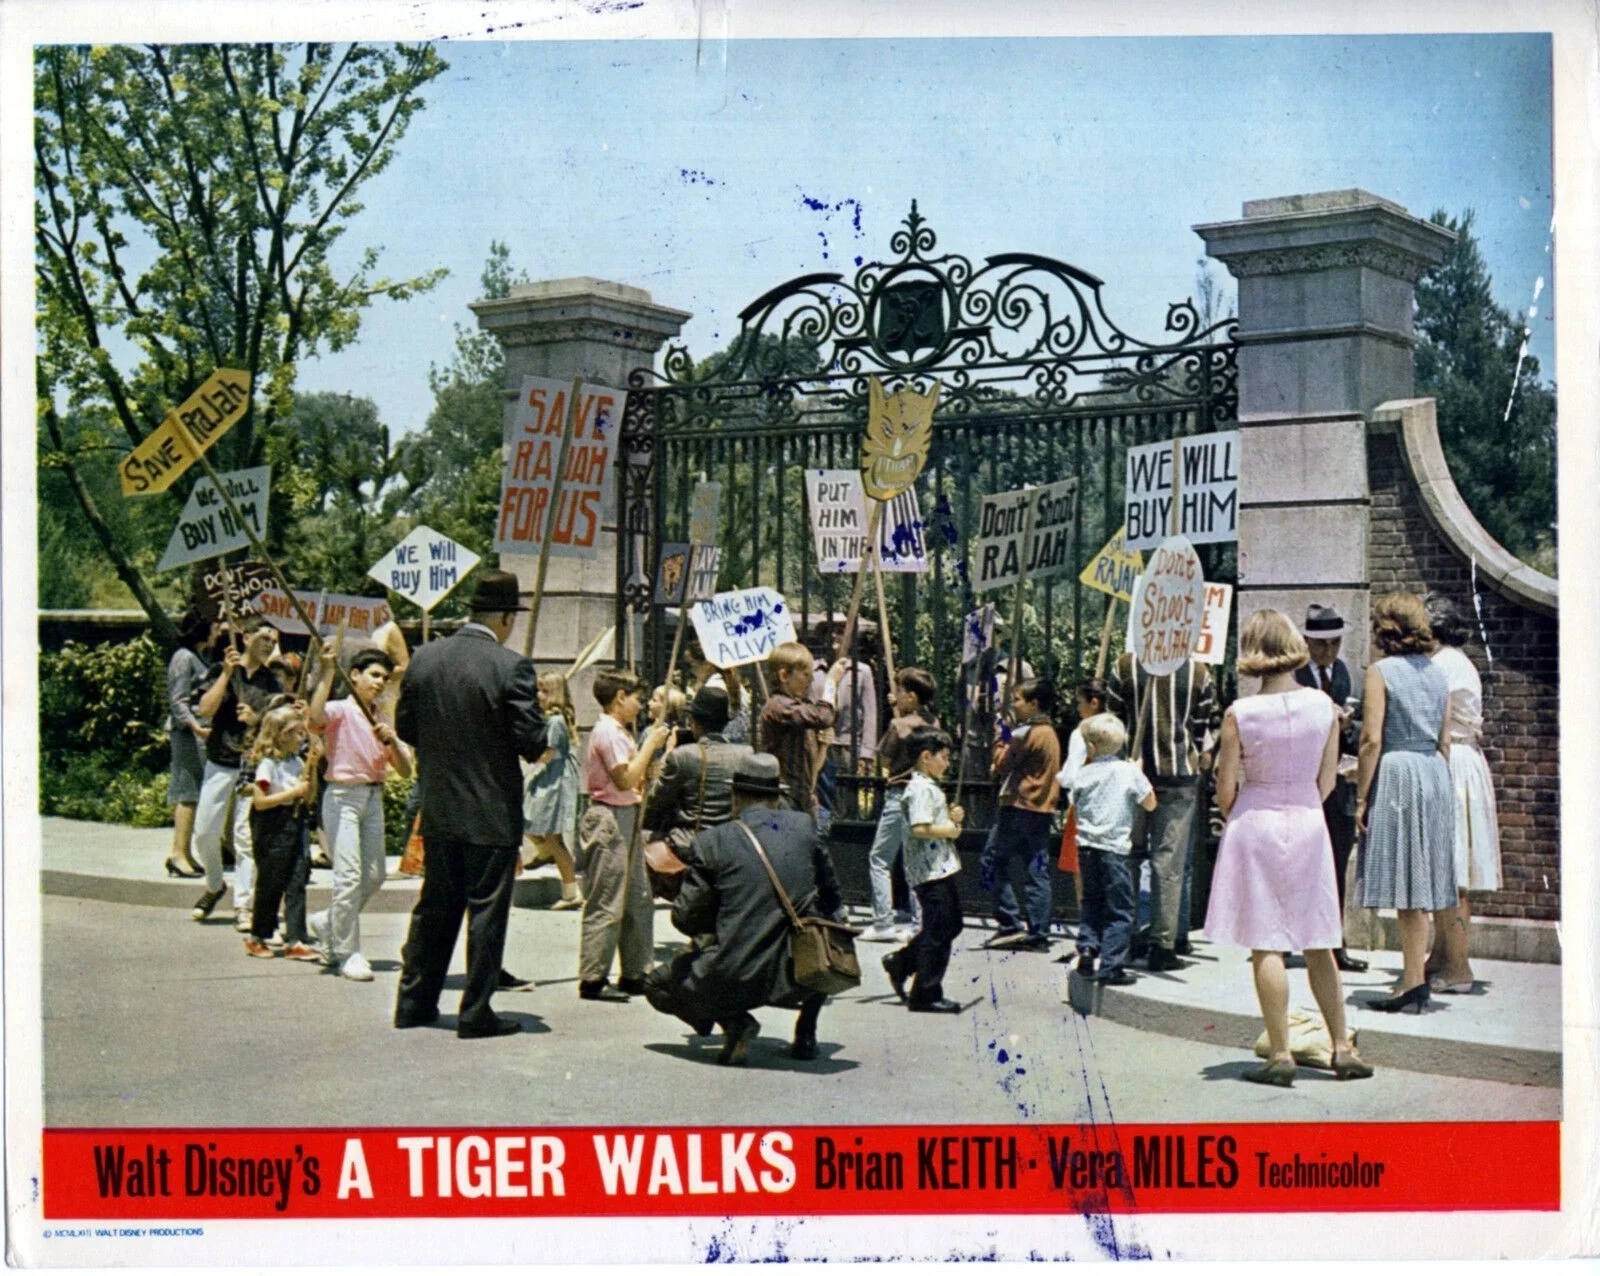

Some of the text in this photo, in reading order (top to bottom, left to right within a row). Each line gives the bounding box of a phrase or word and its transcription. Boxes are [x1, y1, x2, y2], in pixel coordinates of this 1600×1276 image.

[524, 388, 614, 441] SAVE
[124, 436, 183, 491] SAVE
[1131, 441, 1238, 494] WE WILL
[818, 482, 850, 503] PUT
[1127, 488, 1237, 541] BUY HIM
[180, 515, 216, 550] BUY
[498, 487, 600, 547] FOR US
[818, 508, 858, 528] HIM
[395, 545, 419, 565] WE
[822, 536, 837, 559] IN
